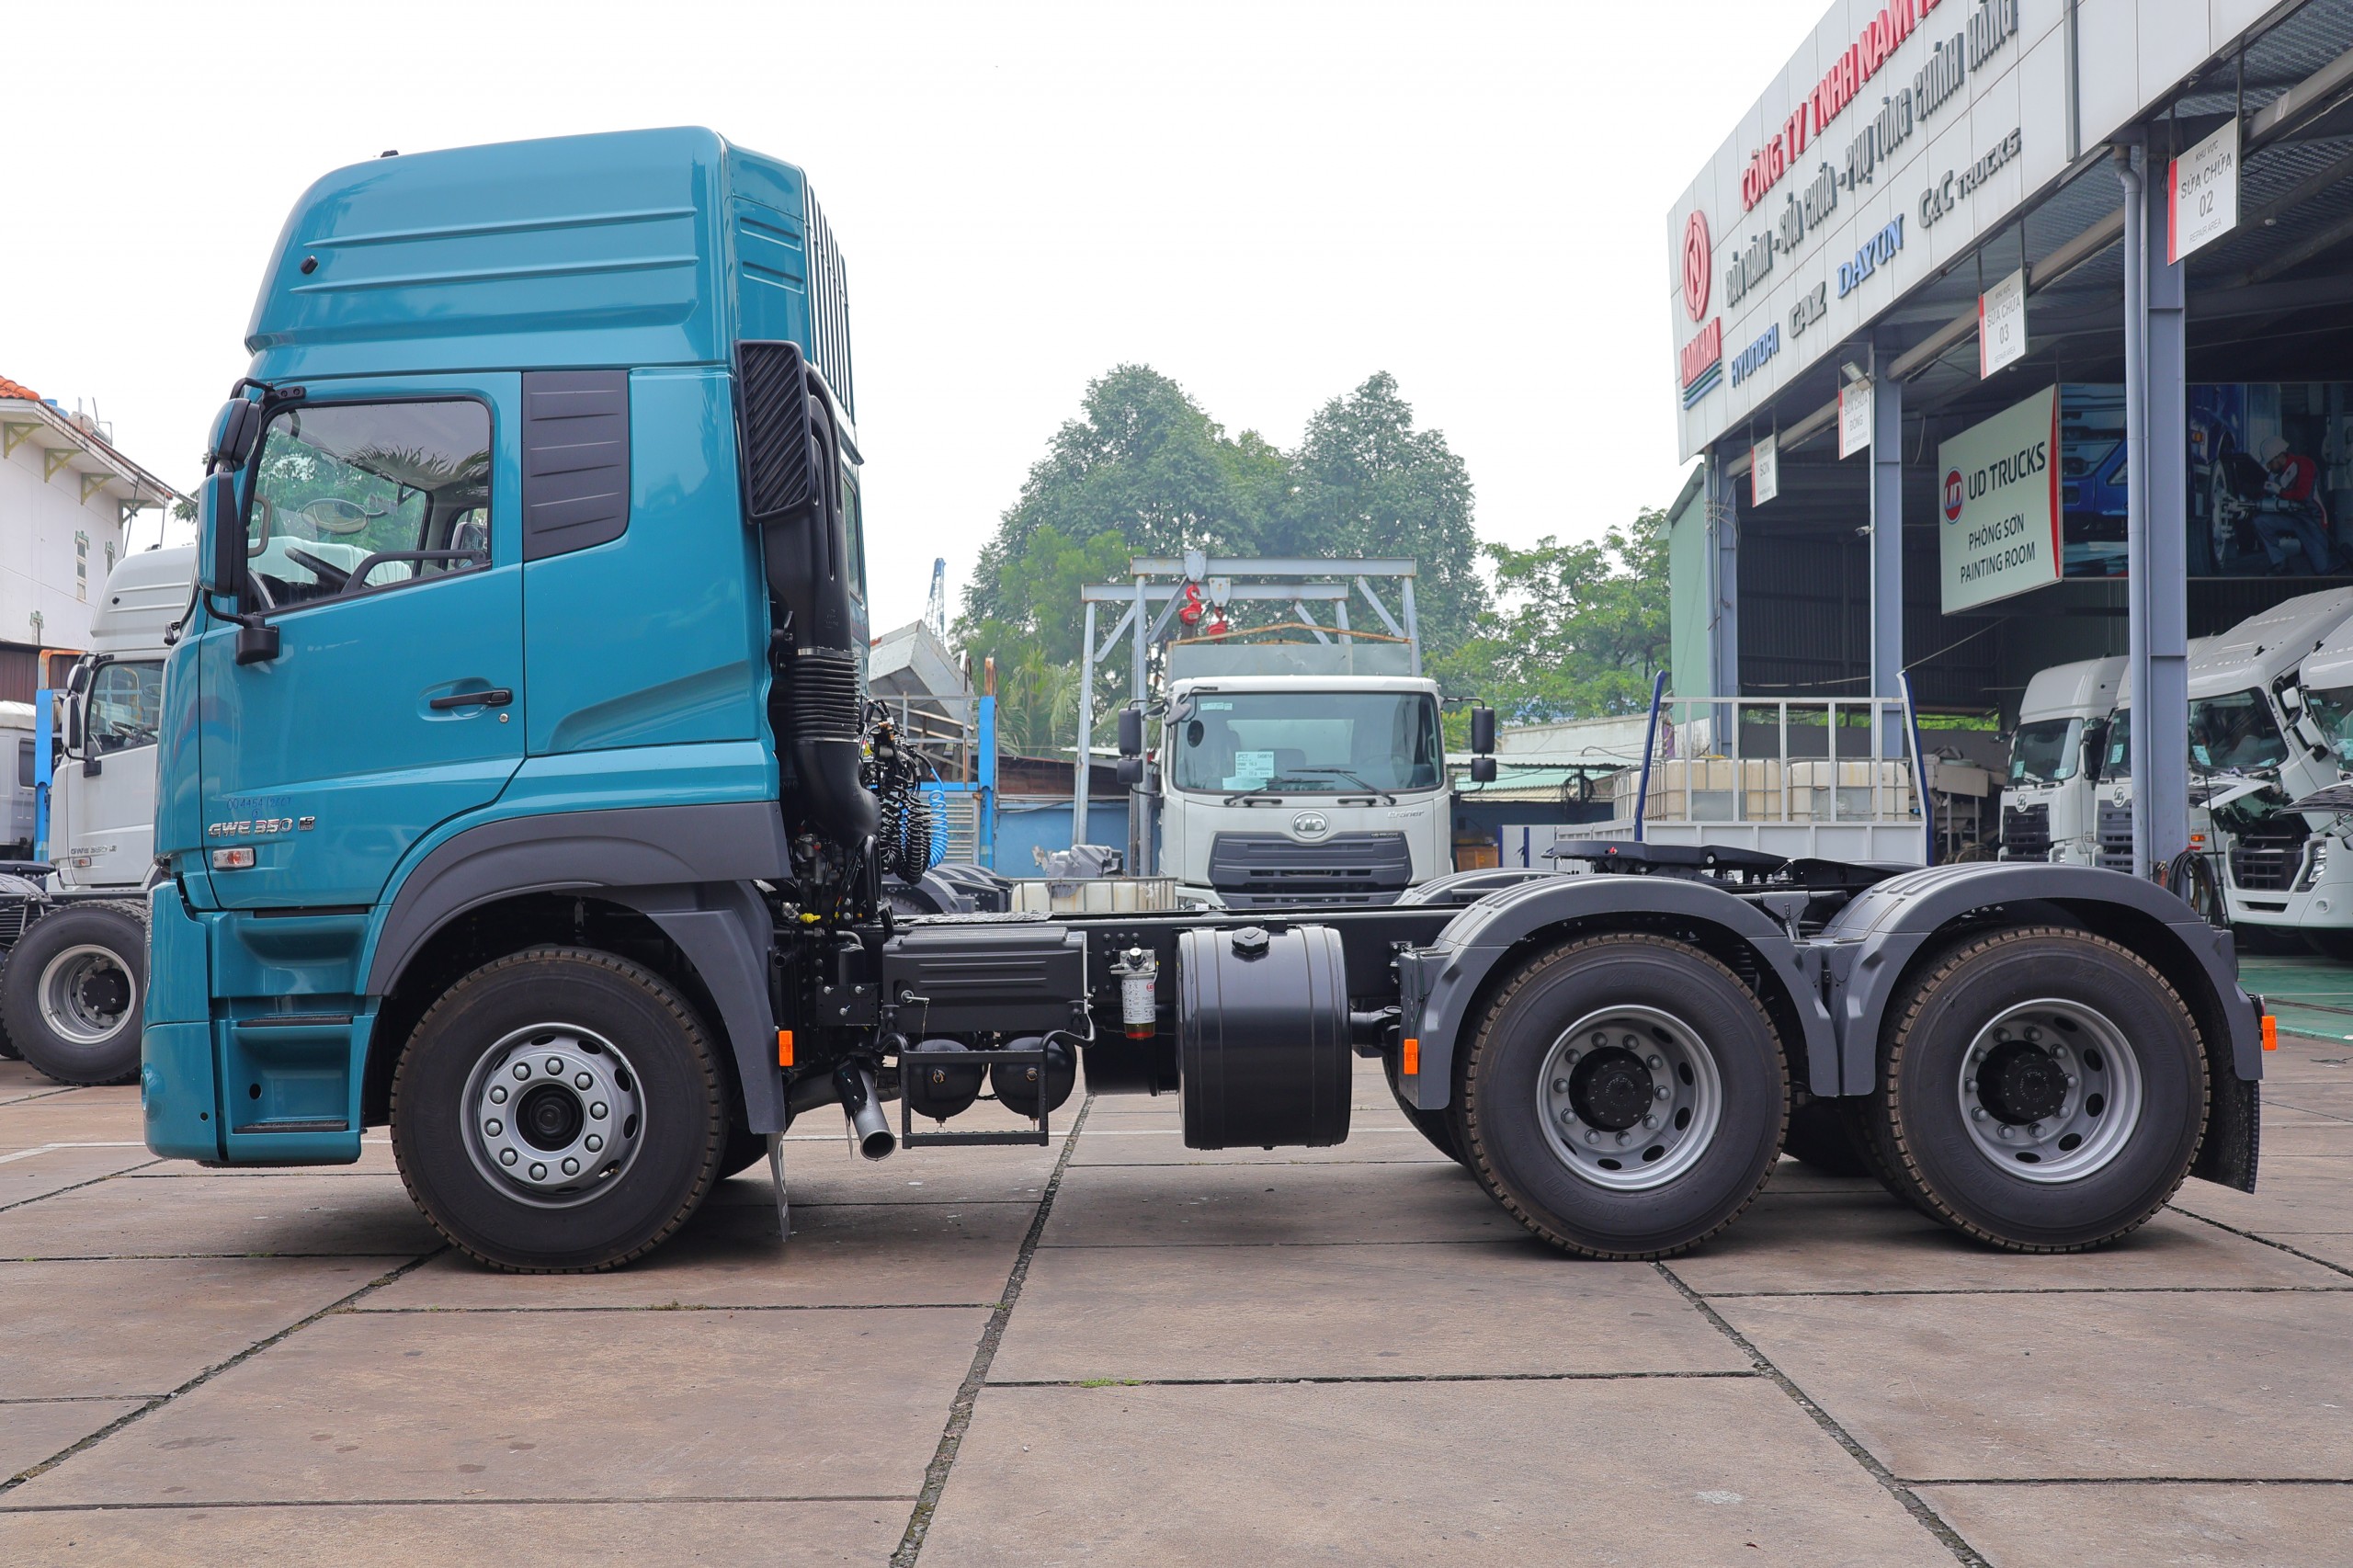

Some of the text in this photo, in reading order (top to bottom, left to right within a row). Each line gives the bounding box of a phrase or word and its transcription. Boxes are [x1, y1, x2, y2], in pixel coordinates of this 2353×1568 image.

[1783, 102, 1807, 165] TY
[1808, 43, 1859, 137] TNHH
[1859, 0, 1915, 83] NAM
[1917, 127, 2021, 229] C&C TRUCKS
[2199, 189, 2214, 218] 02
[1837, 213, 1904, 300] DAYUN
[1788, 280, 1826, 339] GAZ
[1999, 323, 2010, 345] 03
[1731, 322, 1779, 389] HYUNDAI
[1968, 466, 1987, 501] UD
[1989, 441, 2046, 492] TRUCKS
[1968, 513, 2025, 551] PHÒNG SƠN
[1961, 541, 2036, 584] PAINTING ROOM
[208, 821, 251, 837] GWE
[254, 817, 293, 835] 350
